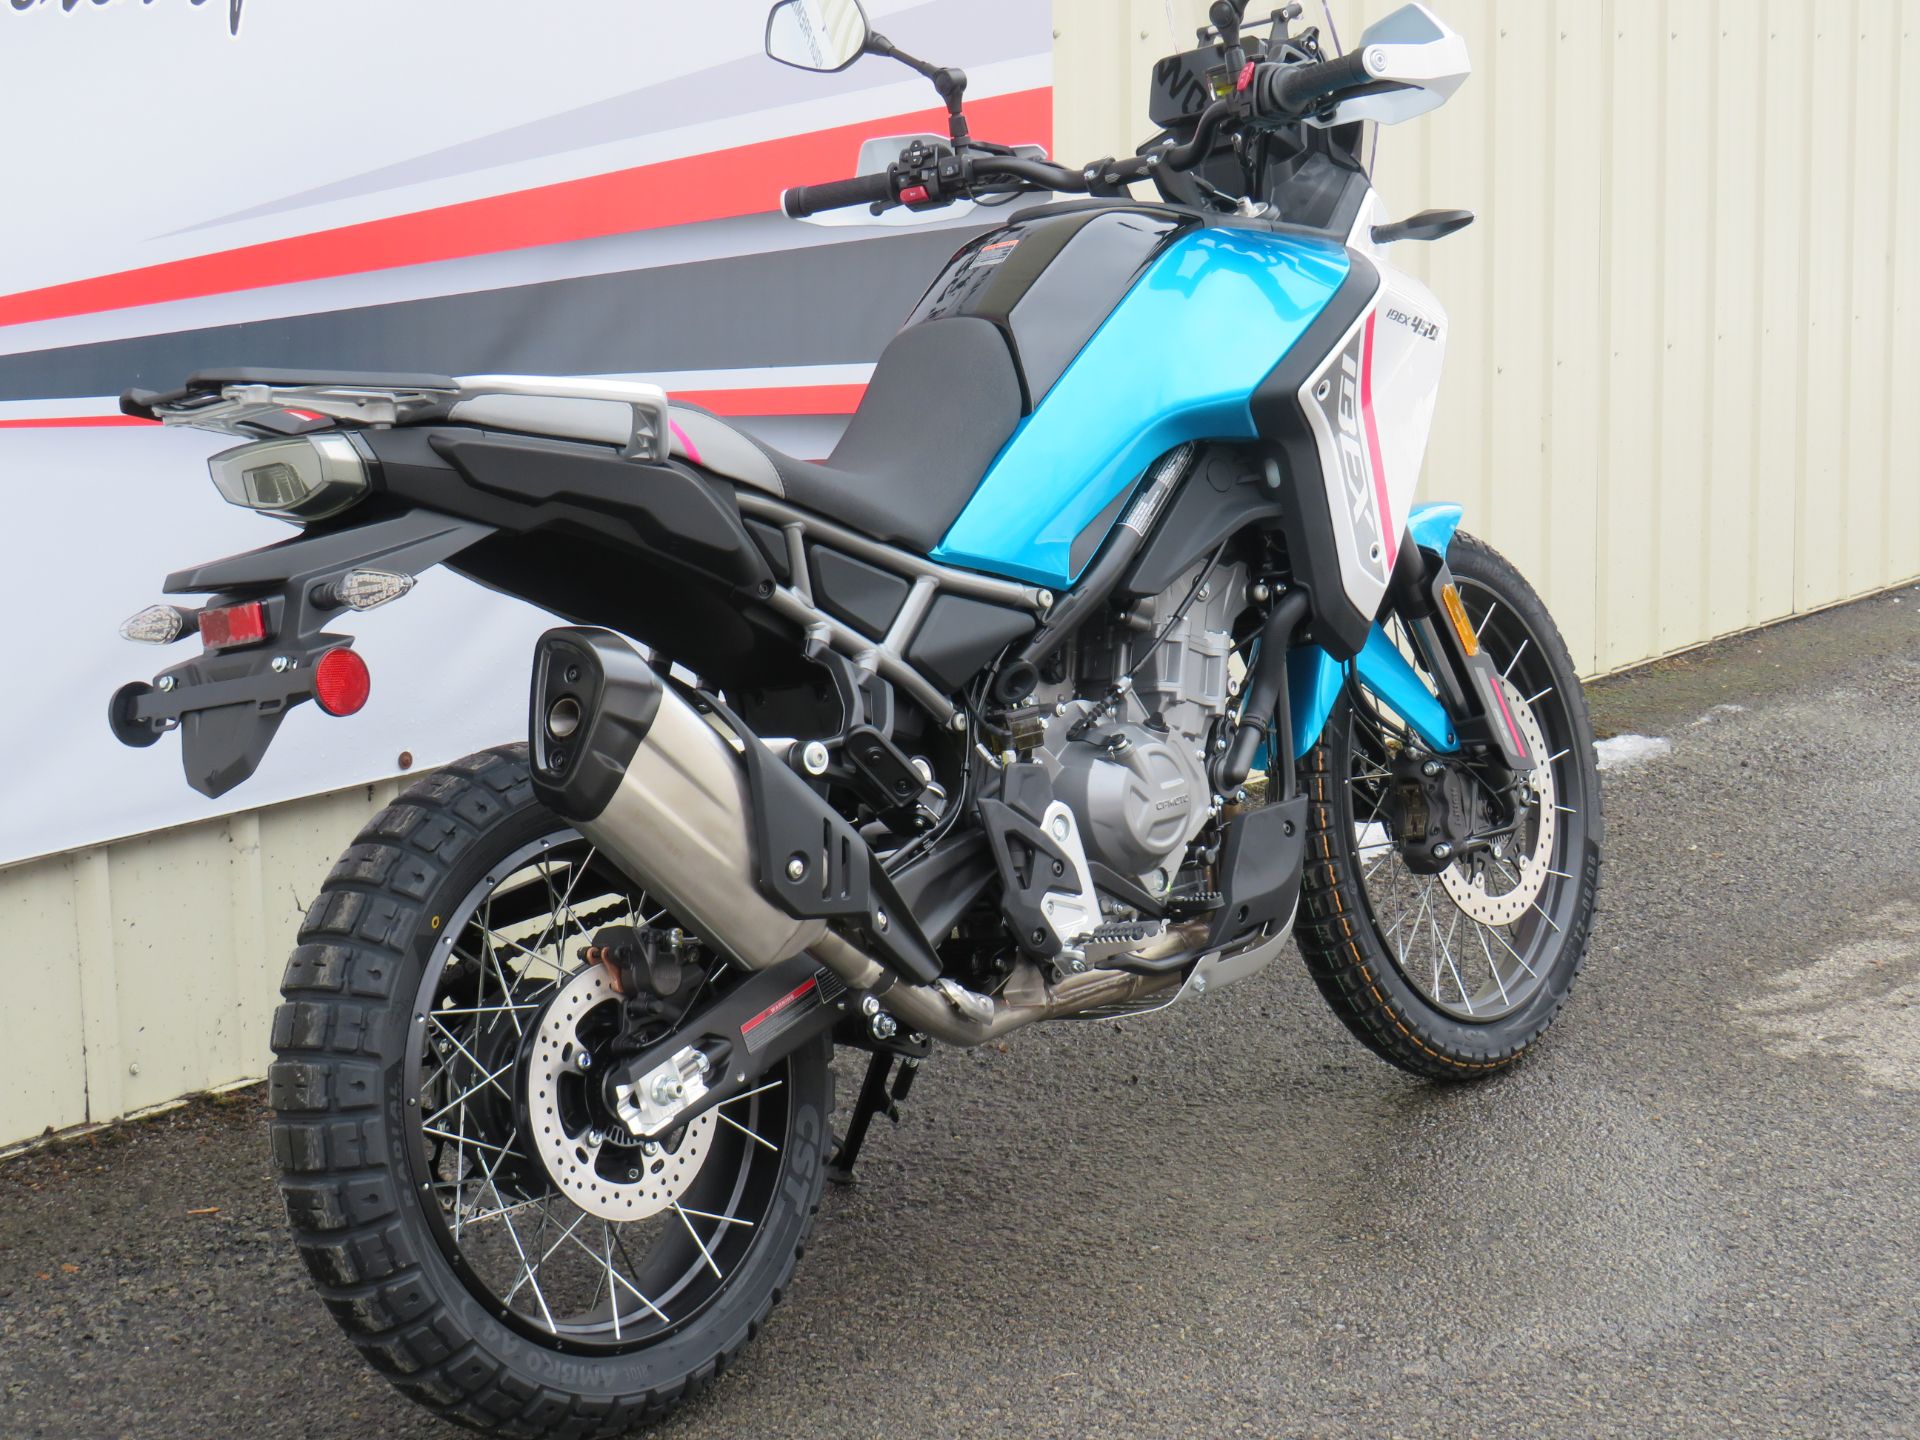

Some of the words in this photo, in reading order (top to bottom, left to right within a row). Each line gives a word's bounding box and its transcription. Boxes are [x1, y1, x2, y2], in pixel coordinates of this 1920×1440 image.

[1386, 308, 1411, 326] IBEX
[1411, 316, 1440, 341] 450
[1337, 352, 1376, 535] IBEX
[784, 1103, 819, 1218] CST
[526, 1350, 618, 1388] AMBRO
